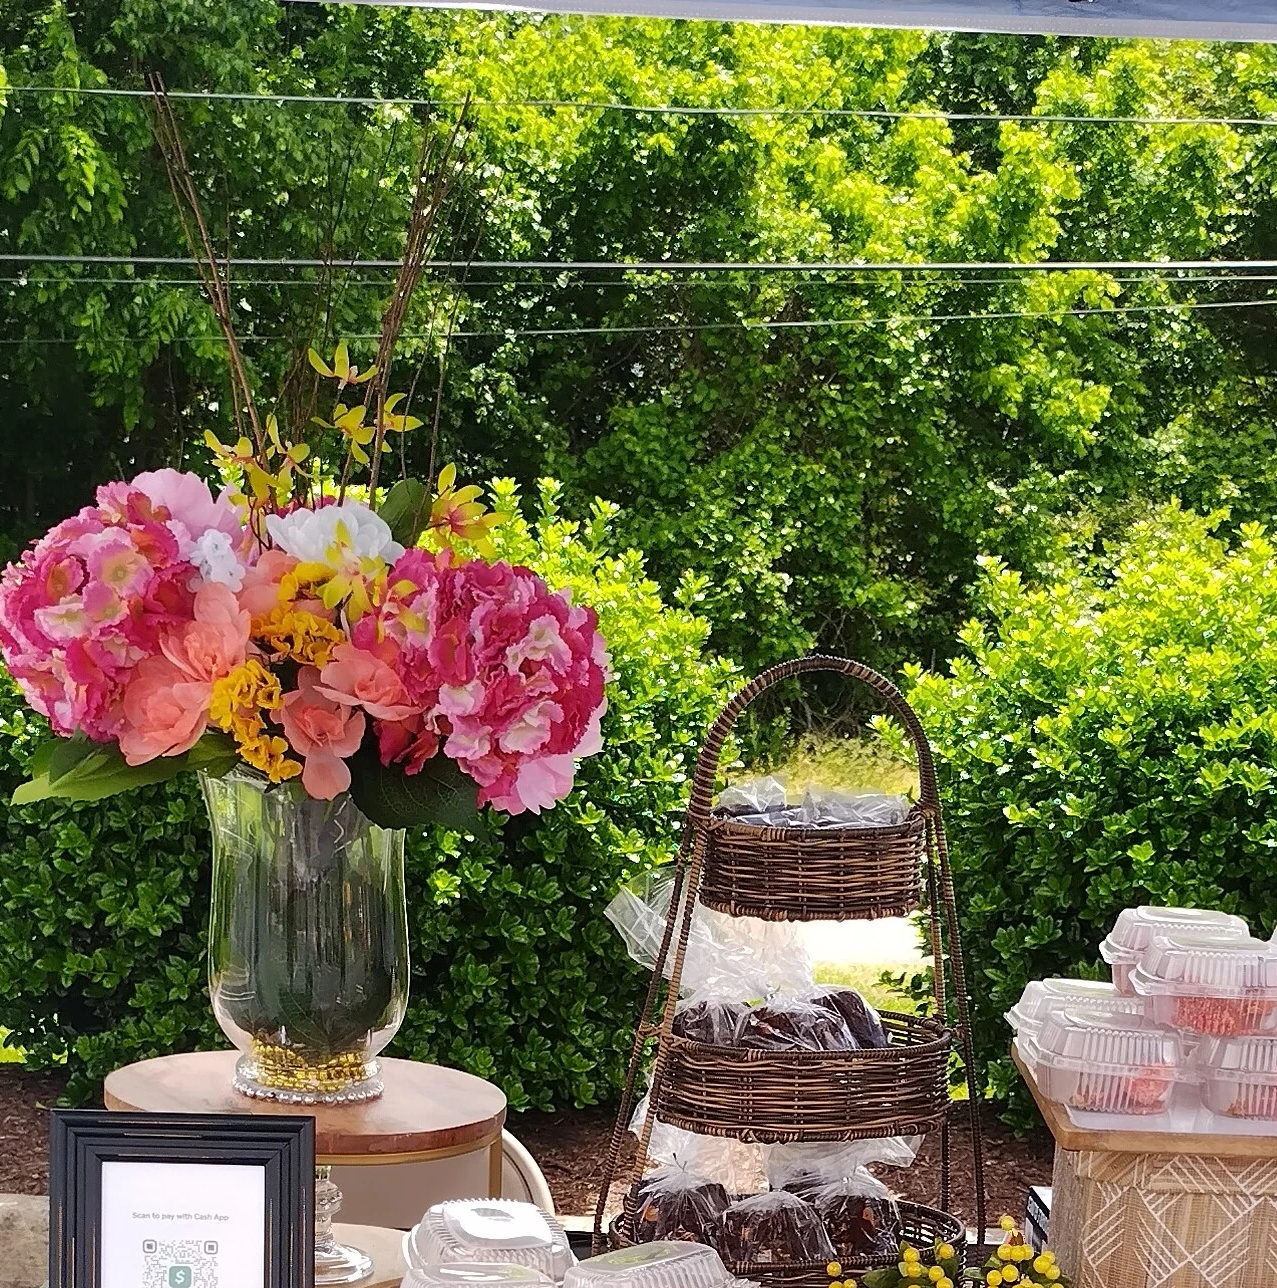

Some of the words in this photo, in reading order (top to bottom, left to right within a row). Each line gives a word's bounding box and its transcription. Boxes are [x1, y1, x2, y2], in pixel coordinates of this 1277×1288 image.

[162, 1213, 175, 1221] pay
[194, 1213, 212, 1221] Cash
[214, 1214, 229, 1222] App
